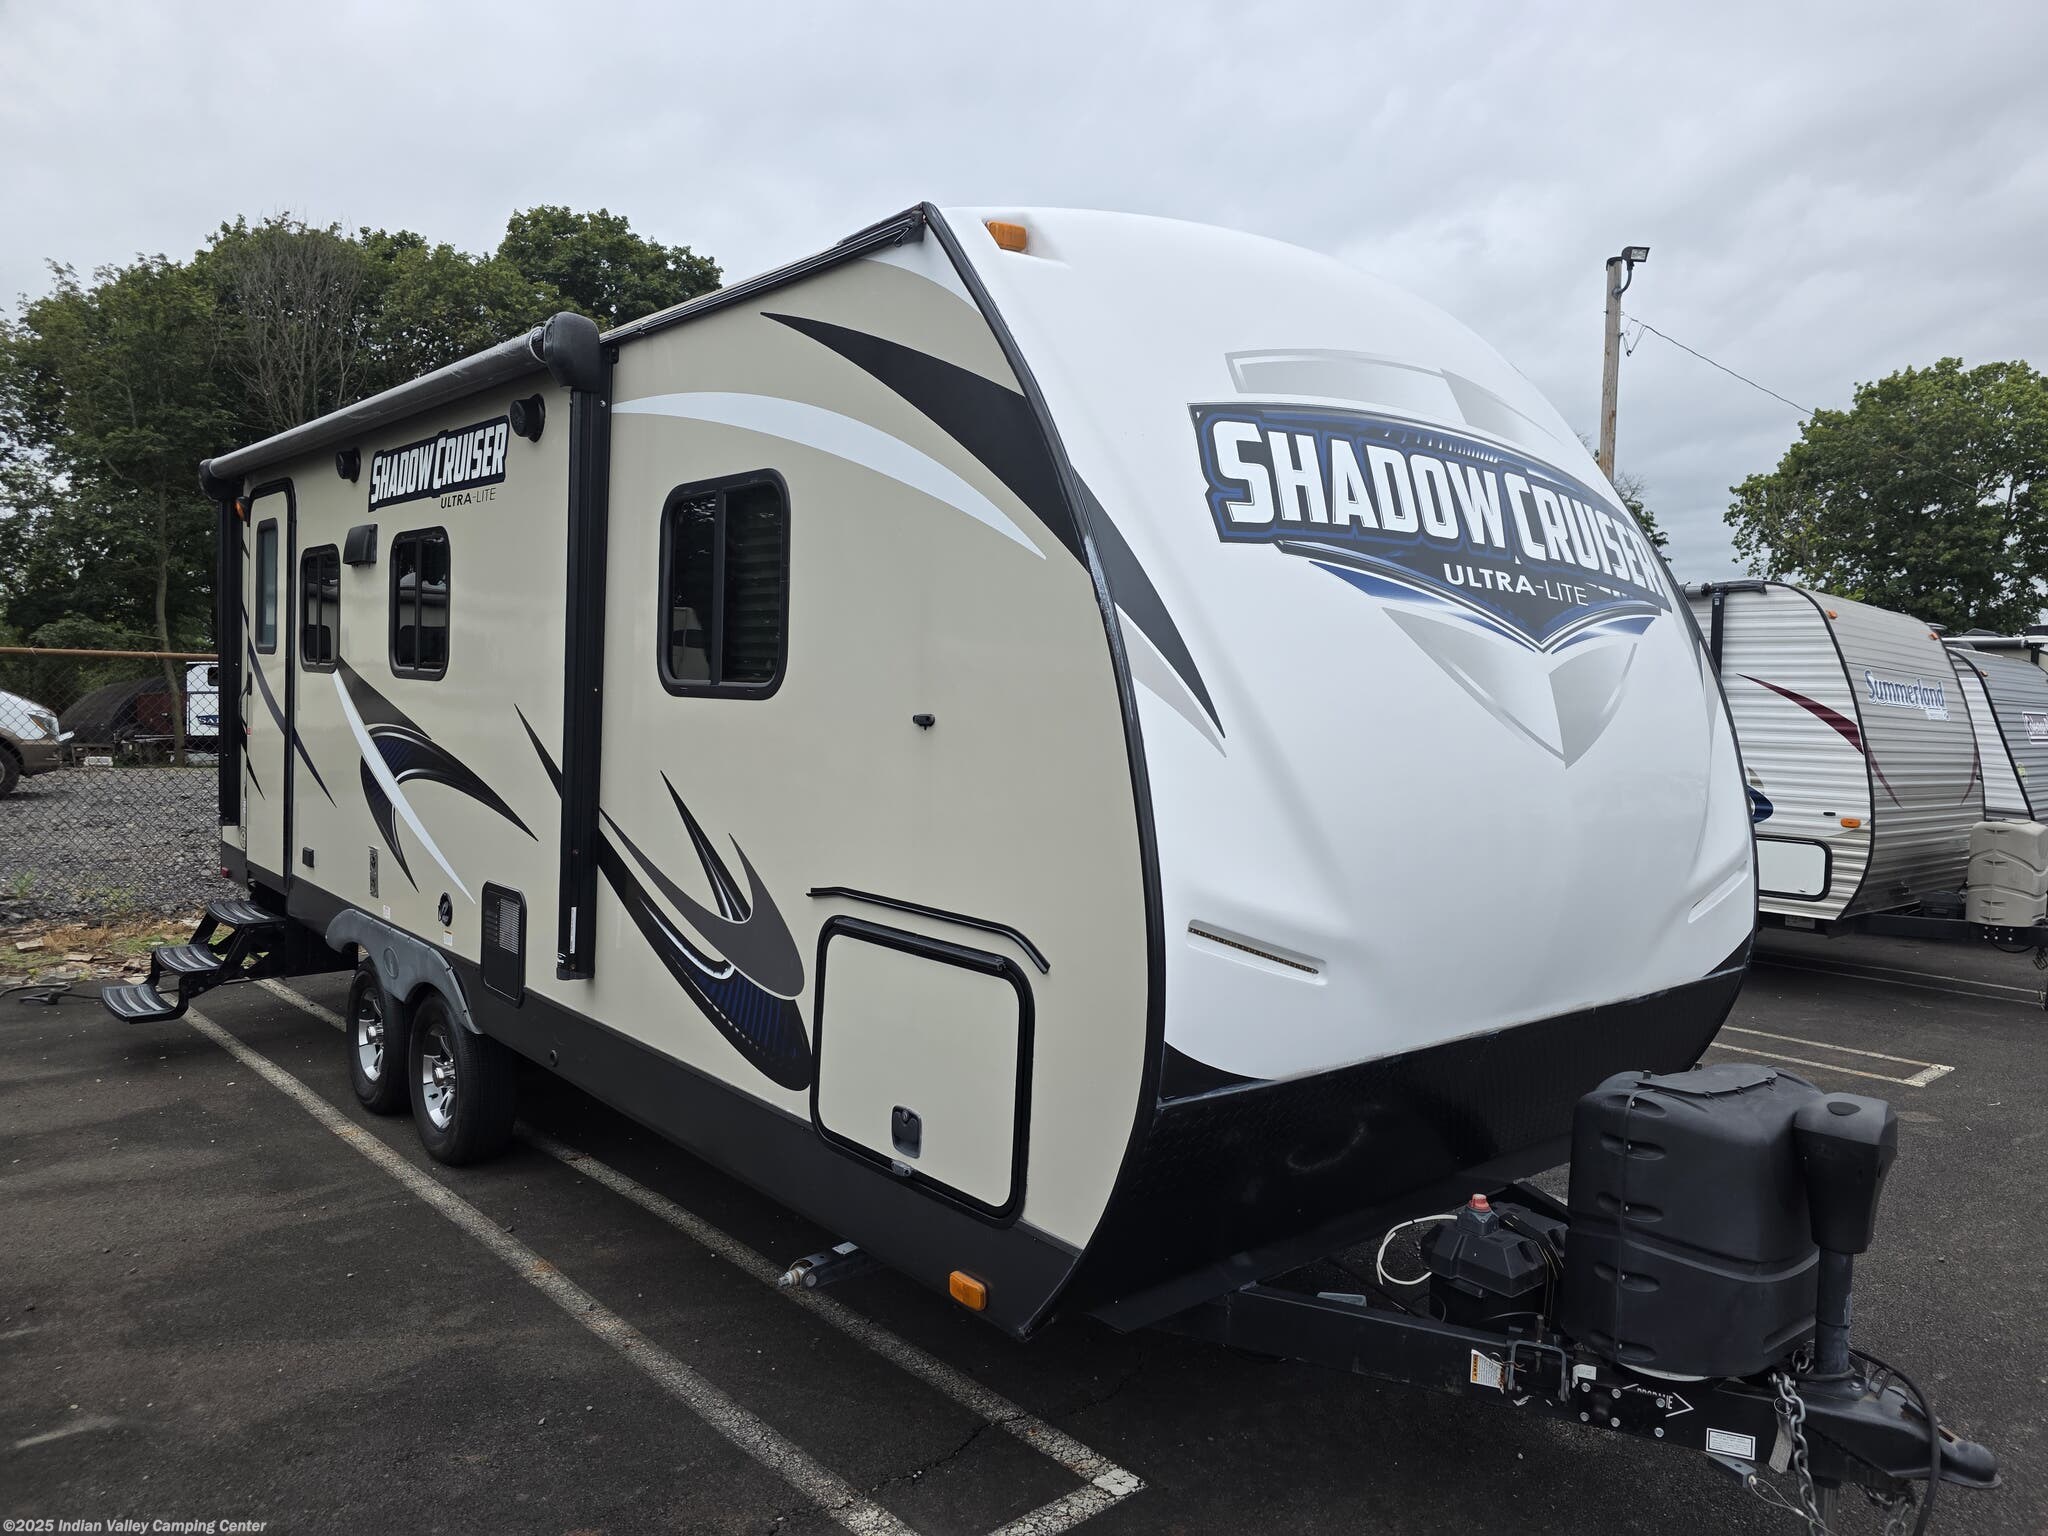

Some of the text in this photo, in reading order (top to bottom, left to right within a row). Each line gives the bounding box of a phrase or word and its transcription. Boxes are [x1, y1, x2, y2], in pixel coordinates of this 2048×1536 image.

[440, 487, 496, 509] ULTRA-LITE
[1443, 563, 1589, 607] ULTRA-LITE
[1865, 670, 1945, 707] Summerland
